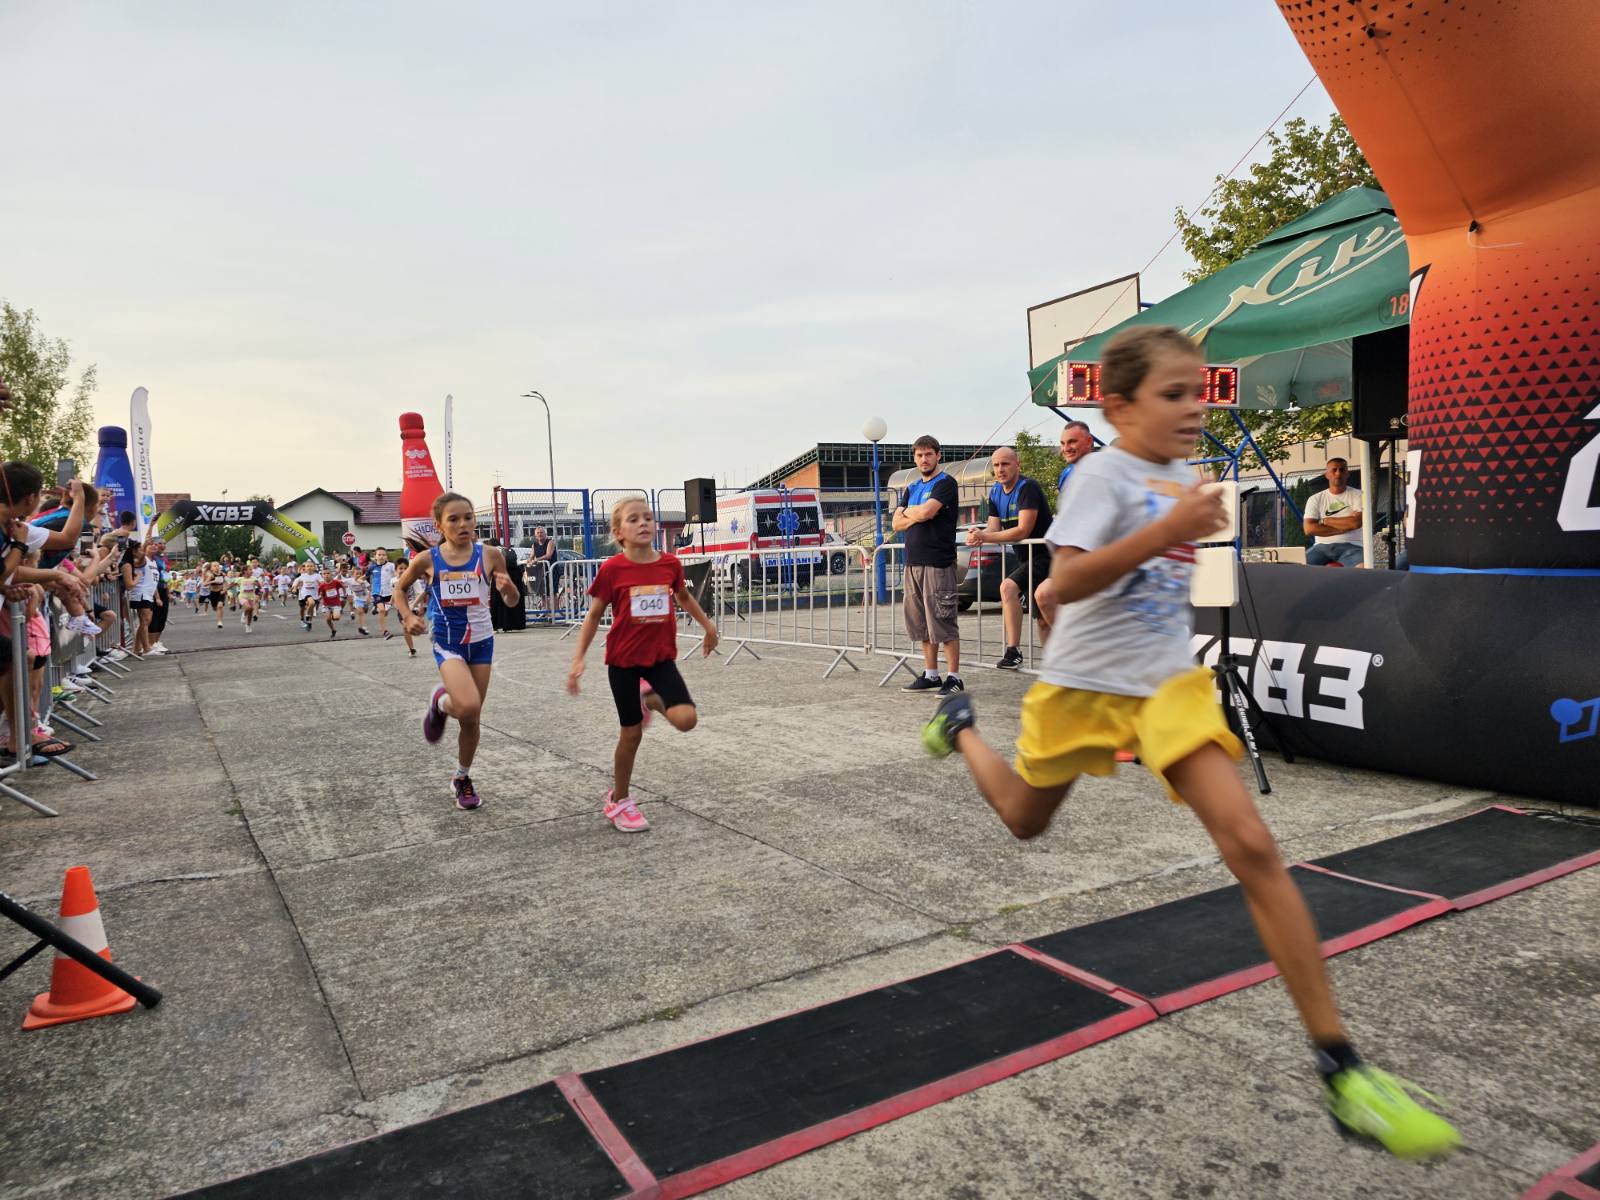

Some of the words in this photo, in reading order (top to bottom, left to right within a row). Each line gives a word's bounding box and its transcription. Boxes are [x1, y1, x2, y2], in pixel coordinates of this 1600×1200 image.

[194, 504, 254, 522] XGB3
[448, 583, 471, 595] 050
[640, 598, 663, 611] 040
